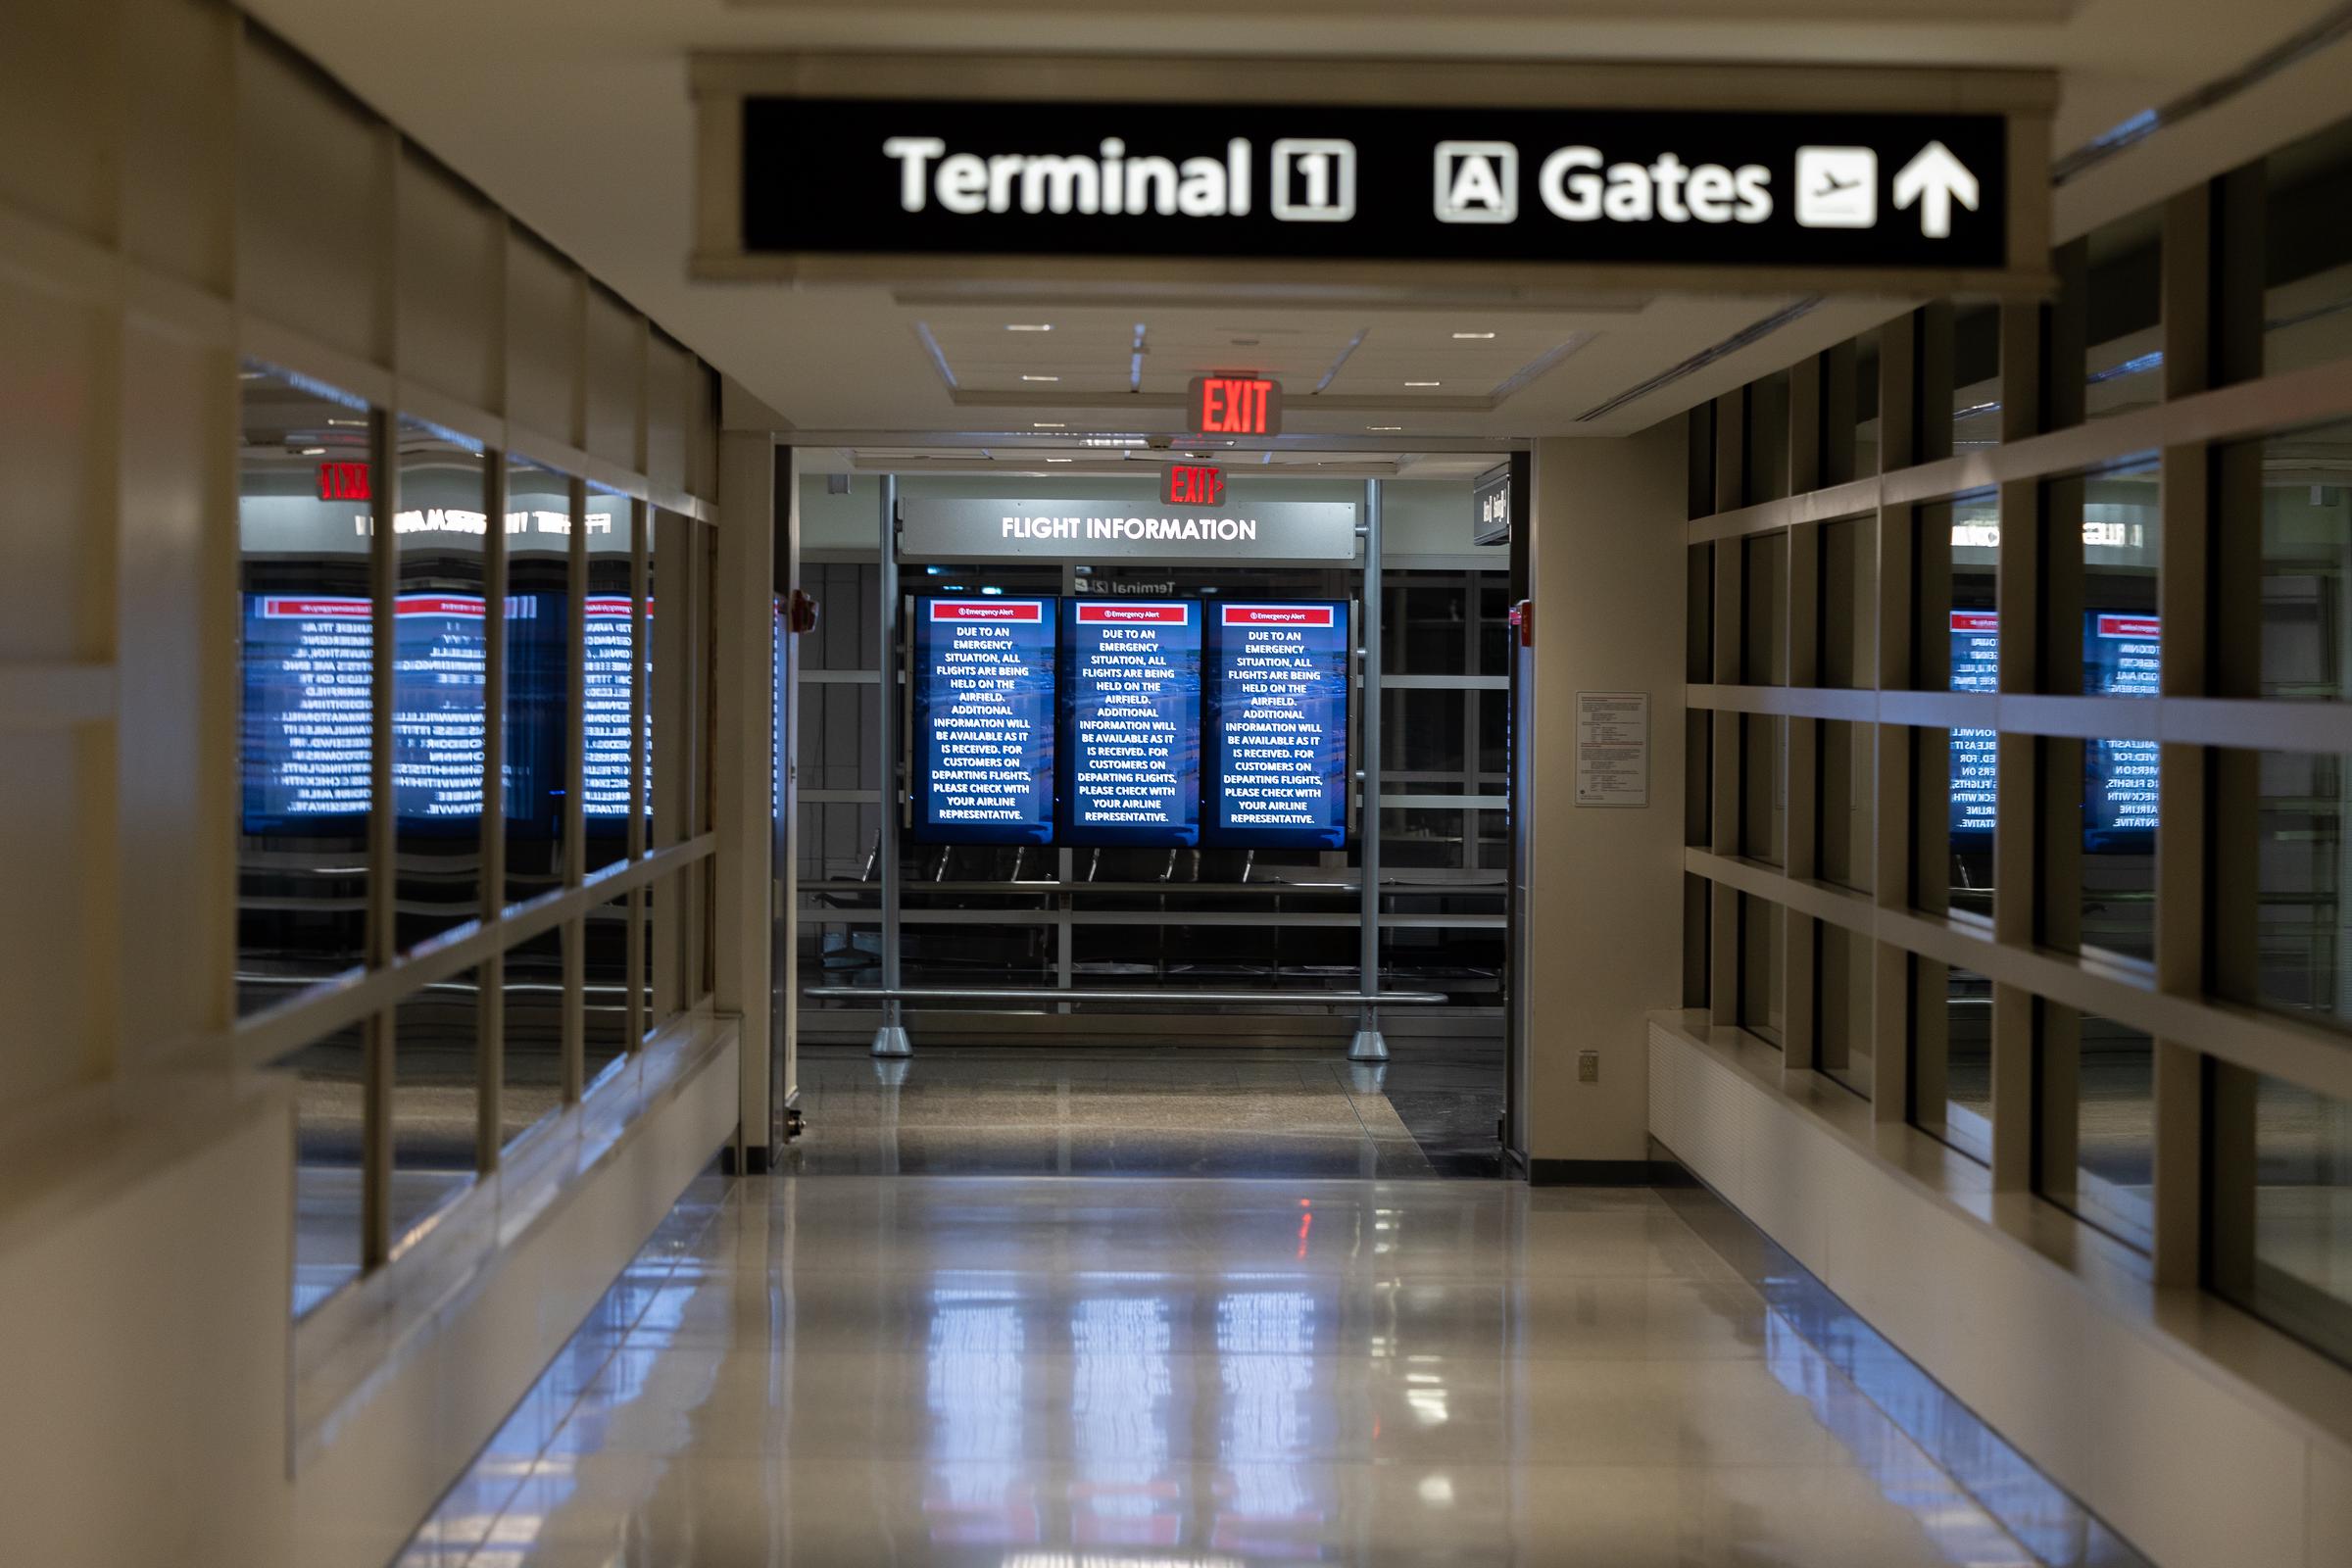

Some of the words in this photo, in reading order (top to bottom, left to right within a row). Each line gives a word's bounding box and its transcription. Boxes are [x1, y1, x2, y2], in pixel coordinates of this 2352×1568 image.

[883, 136, 1252, 218] Terminal
[1296, 153, 1330, 208] 1
[1449, 155, 1503, 210] A
[1539, 145, 1774, 223] Gates
[1202, 379, 1272, 433] EXIT
[1170, 466, 1219, 504] EXIT
[1003, 517, 1080, 539] FLIGHT
[1087, 518, 1256, 540] INFORMATION
[966, 608, 1000, 616] Emergency
[1258, 612, 1292, 621] Emergency
[956, 627, 977, 636] DUE
[979, 627, 993, 636] TO
[1140, 630, 1155, 639] AN
[1100, 643, 1158, 652] EMERGENCY
[945, 654, 1000, 662] SITUATION,
[1091, 656, 1146, 664] SITUATION,
[1237, 658, 1292, 667] SITUATION,
[937, 666, 976, 675] FLIGHTS
[977, 666, 997, 675] ARE
[1083, 668, 1122, 677] FLIGHTS
[1145, 669, 1174, 678] BEING
[1229, 670, 1268, 679] FLIGHTS
[1291, 671, 1320, 680] BEING
[996, 680, 1014, 689] THE
[1142, 682, 1160, 691] THE
[1288, 684, 1306, 693] THE
[959, 693, 1005, 702] AIRFIELD.
[1105, 695, 1152, 704] AIRFIELD.
[952, 706, 1012, 714] ADDITIONAL
[1098, 709, 1158, 717] ADDITIONAL
[934, 718, 1004, 727] INFORMATION
[1080, 721, 1151, 730] INFORMATION
[936, 731, 948, 740] BE
[950, 732, 1003, 741] AVAILABLE
[1096, 734, 1149, 743] AVAILABLE
[953, 745, 1001, 754] RECEIVED.
[1149, 748, 1168, 757] FOR
[1234, 749, 1243, 758] IS
[944, 758, 1002, 766] CUSTOMERS
[1150, 760, 1165, 769] ON
[932, 770, 987, 779] DEPARTING
[990, 771, 1031, 781] FLIGHTS,
[1078, 773, 1133, 782] DEPARTING
[1136, 774, 1177, 783] FLIGHTS,
[1224, 775, 1279, 784] DEPARTING
[1282, 776, 1323, 785] FLIGHTS,
[970, 784, 1002, 793] CHECK
[1080, 786, 1114, 795] PLEASE
[1149, 787, 1175, 796] WITH
[1226, 788, 1260, 797] PLEASE
[947, 797, 975, 806] YOUR
[940, 809, 1023, 819] REPRESENTATIVE.
[1086, 812, 1169, 821] REPRESENTATIVE.
[1232, 814, 1315, 823] REPRESENTATIVE.
